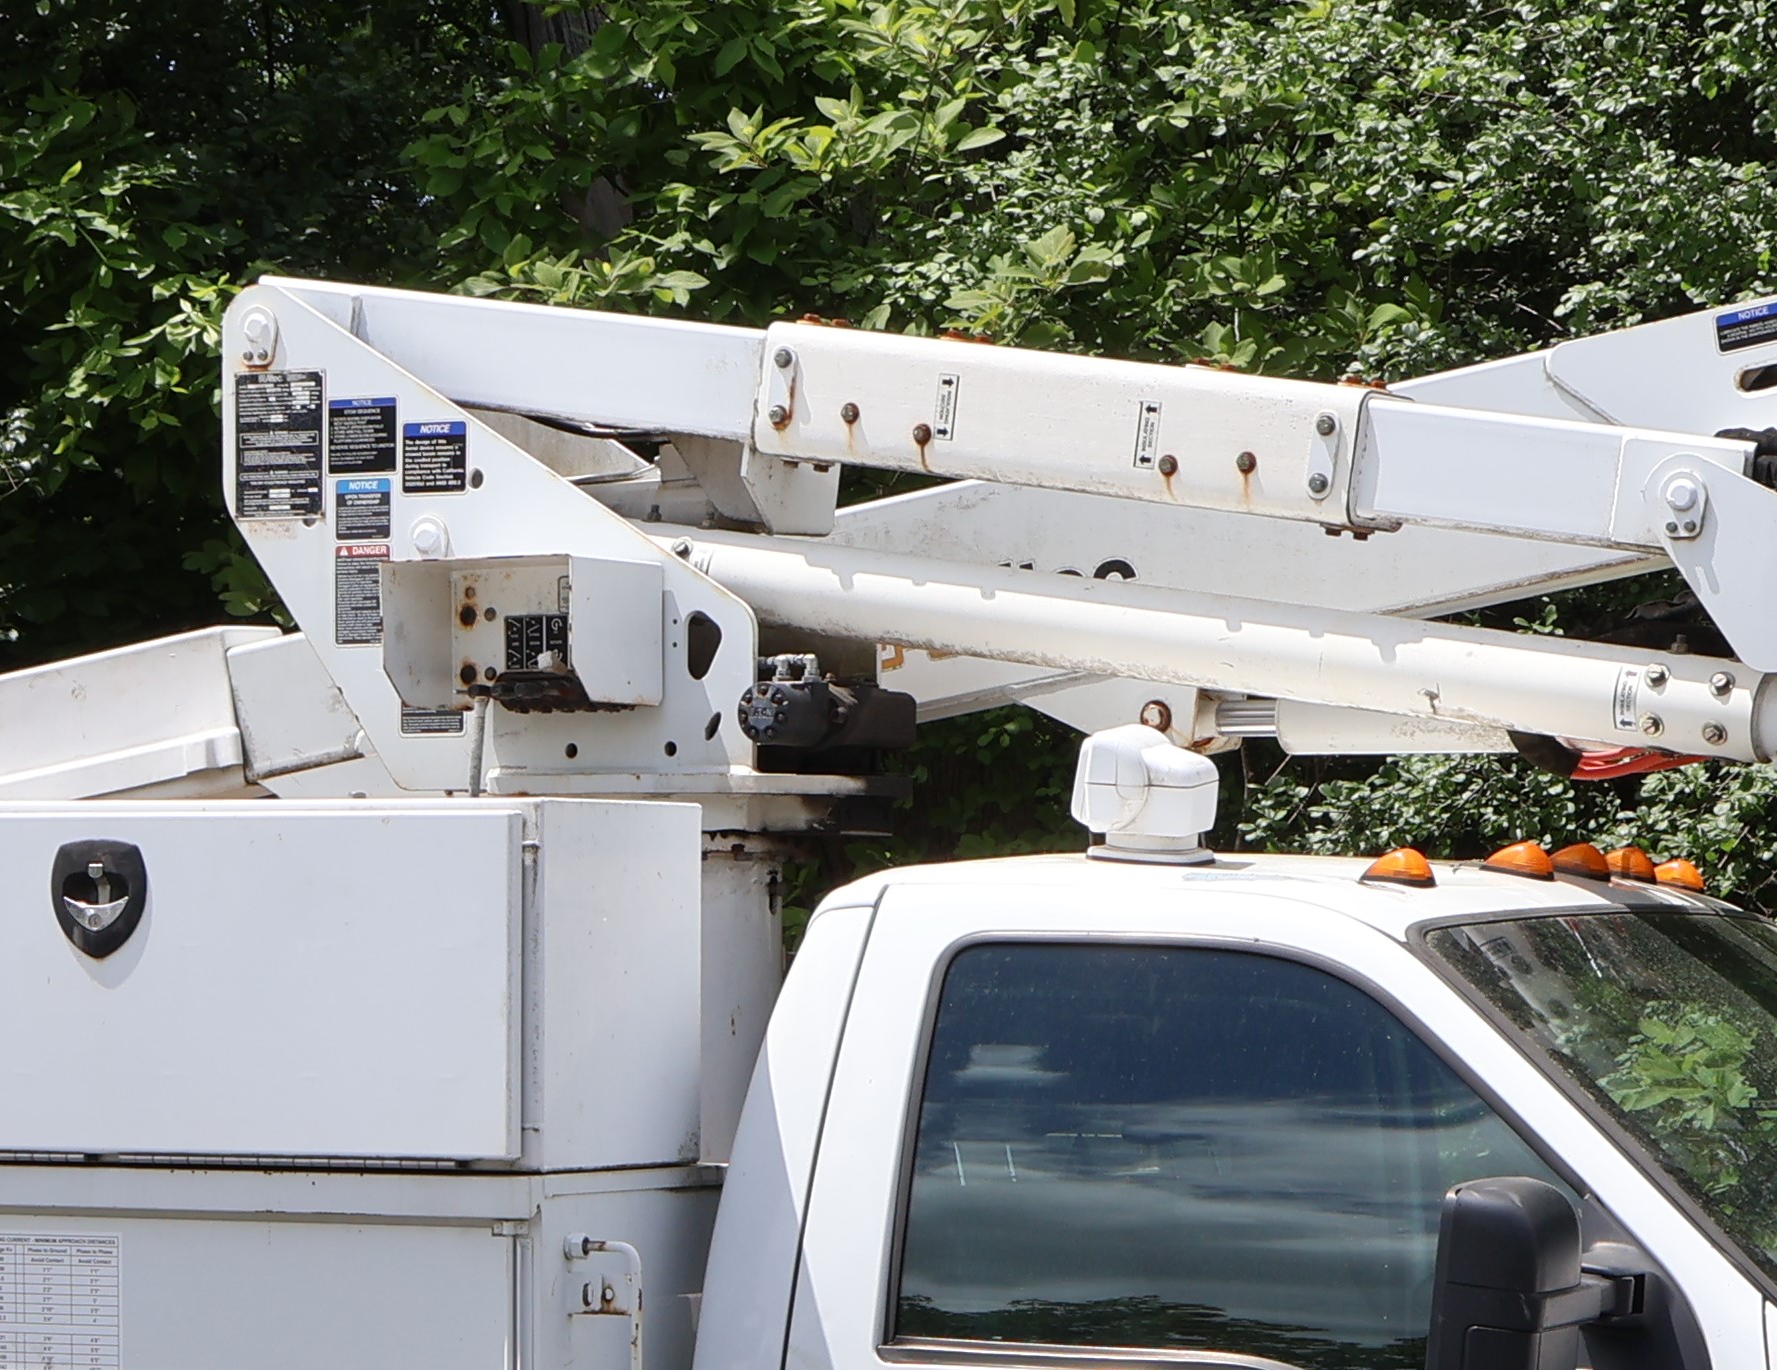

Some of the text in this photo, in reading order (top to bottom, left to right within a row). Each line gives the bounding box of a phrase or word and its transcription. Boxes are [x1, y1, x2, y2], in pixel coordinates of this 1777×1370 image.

[1738, 306, 1769, 320] NOTICE
[420, 424, 451, 434] NOTICE
[349, 481, 379, 490] NOTICE
[352, 546, 387, 555] DANGER
